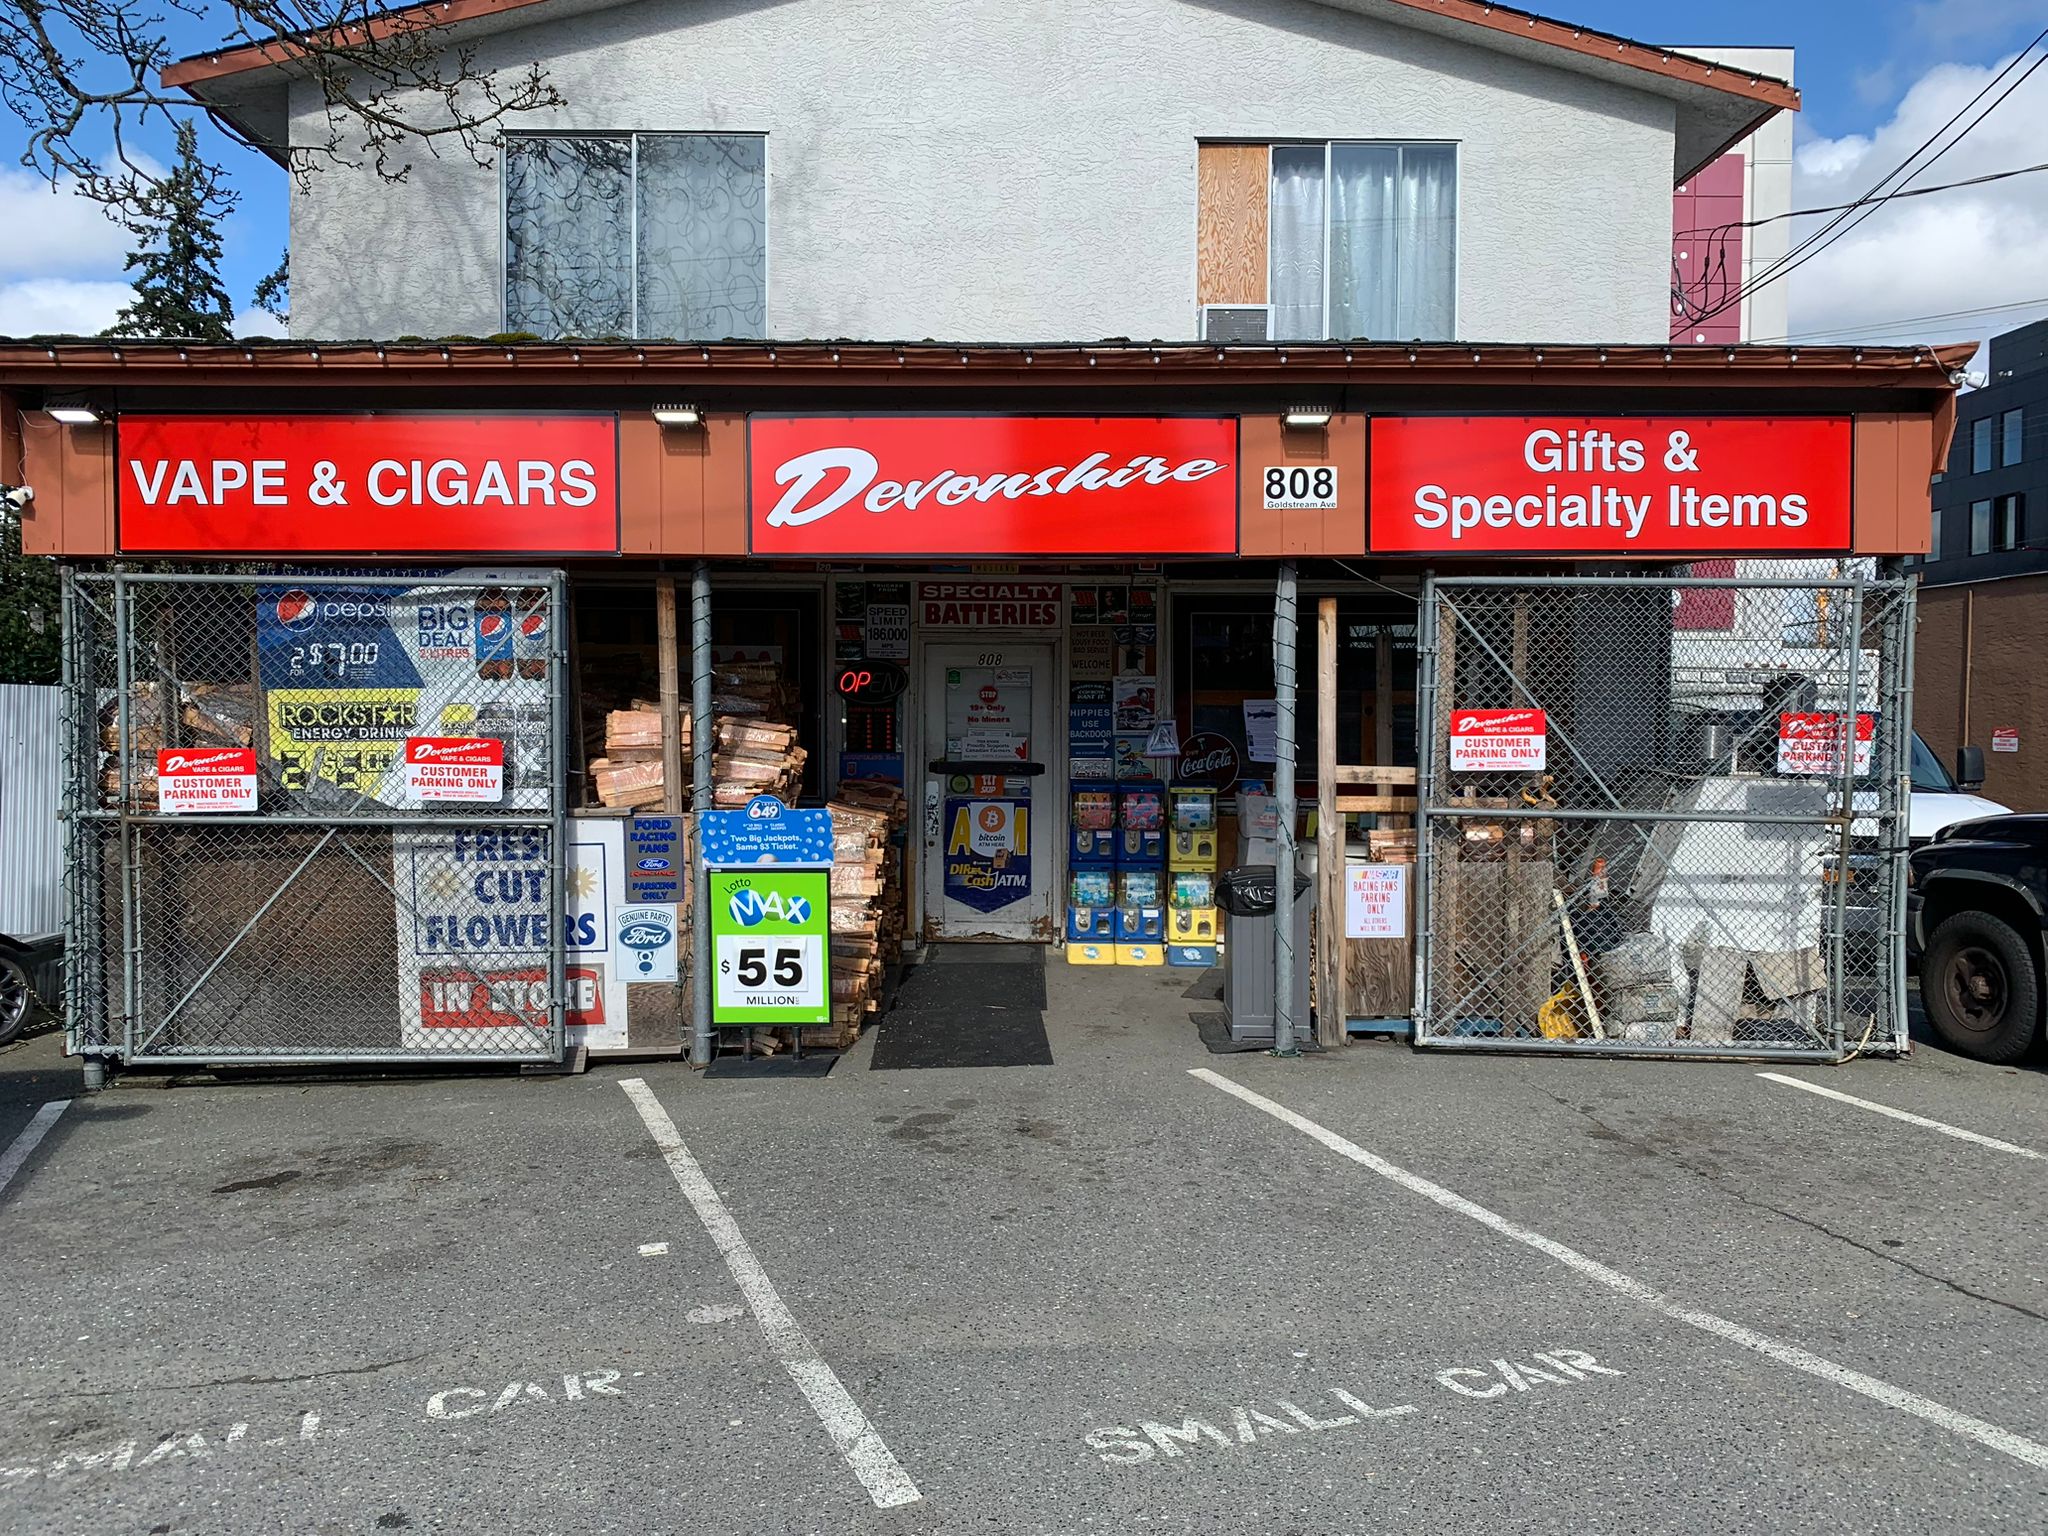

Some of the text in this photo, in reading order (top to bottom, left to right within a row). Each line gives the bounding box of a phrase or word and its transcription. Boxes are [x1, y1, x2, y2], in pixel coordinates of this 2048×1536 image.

[1523, 429, 1699, 473] Gifts &
[130, 459, 597, 507] VAPE & CIGARS
[765, 447, 1229, 528] Devonshire
[1266, 468, 1333, 499] 808
[1413, 484, 1809, 539] Specialty Items
[923, 585, 1058, 598] SPECIALTY
[324, 599, 391, 621] pepsi
[869, 607, 907, 616] SPEED
[925, 603, 1056, 624] BATTERIES
[418, 606, 469, 631] BIG
[872, 617, 905, 625] LIMIT
[418, 632, 470, 647] DEAL
[291, 647, 304, 668] 2
[978, 654, 1002, 665] 808
[1072, 659, 1110, 669] WELCOME
[289, 669, 304, 677] FOR
[840, 671, 900, 692] OPEN
[987, 704, 1005, 712] Only
[1070, 709, 1111, 717] HIPPIES
[1081, 720, 1100, 728] USE
[293, 726, 405, 739] ENERGY DRINK
[1070, 730, 1112, 738] BACKDOOR
[1465, 738, 1531, 747] CUSTOMER
[1456, 749, 1540, 758] PARKING ONLY
[1783, 751, 1833, 762] PARKING
[421, 766, 488, 777] CUSTOMER
[173, 777, 241, 788] CUSTOMER
[411, 777, 497, 788] PARKING ONLY
[164, 789, 251, 799] PARKING ONLY
[634, 820, 672, 830] FORD
[630, 832, 677, 842] RACING
[749, 834, 761, 843] Big
[763, 834, 802, 843] Jackpots,
[638, 844, 669, 853] FANS
[642, 859, 664, 868] Ford
[474, 869, 546, 904] CUT
[632, 882, 677, 890] PARKING
[723, 878, 751, 894] Lotto
[962, 875, 1026, 887] Cash ATM
[1353, 881, 1398, 891] RACING FANS
[641, 891, 669, 900] ONLY
[1361, 893, 1391, 903] PARKING
[729, 889, 808, 926] MAX
[1367, 904, 1385, 914] ONLY
[621, 911, 670, 925] GENUINE PARTS
[624, 926, 665, 945] Ford
[432, 980, 470, 1012] IN
[746, 996, 795, 1005] MILLION
[426, 1368, 624, 1420] CAR
[1085, 1348, 1627, 1465] SMALL CAR
